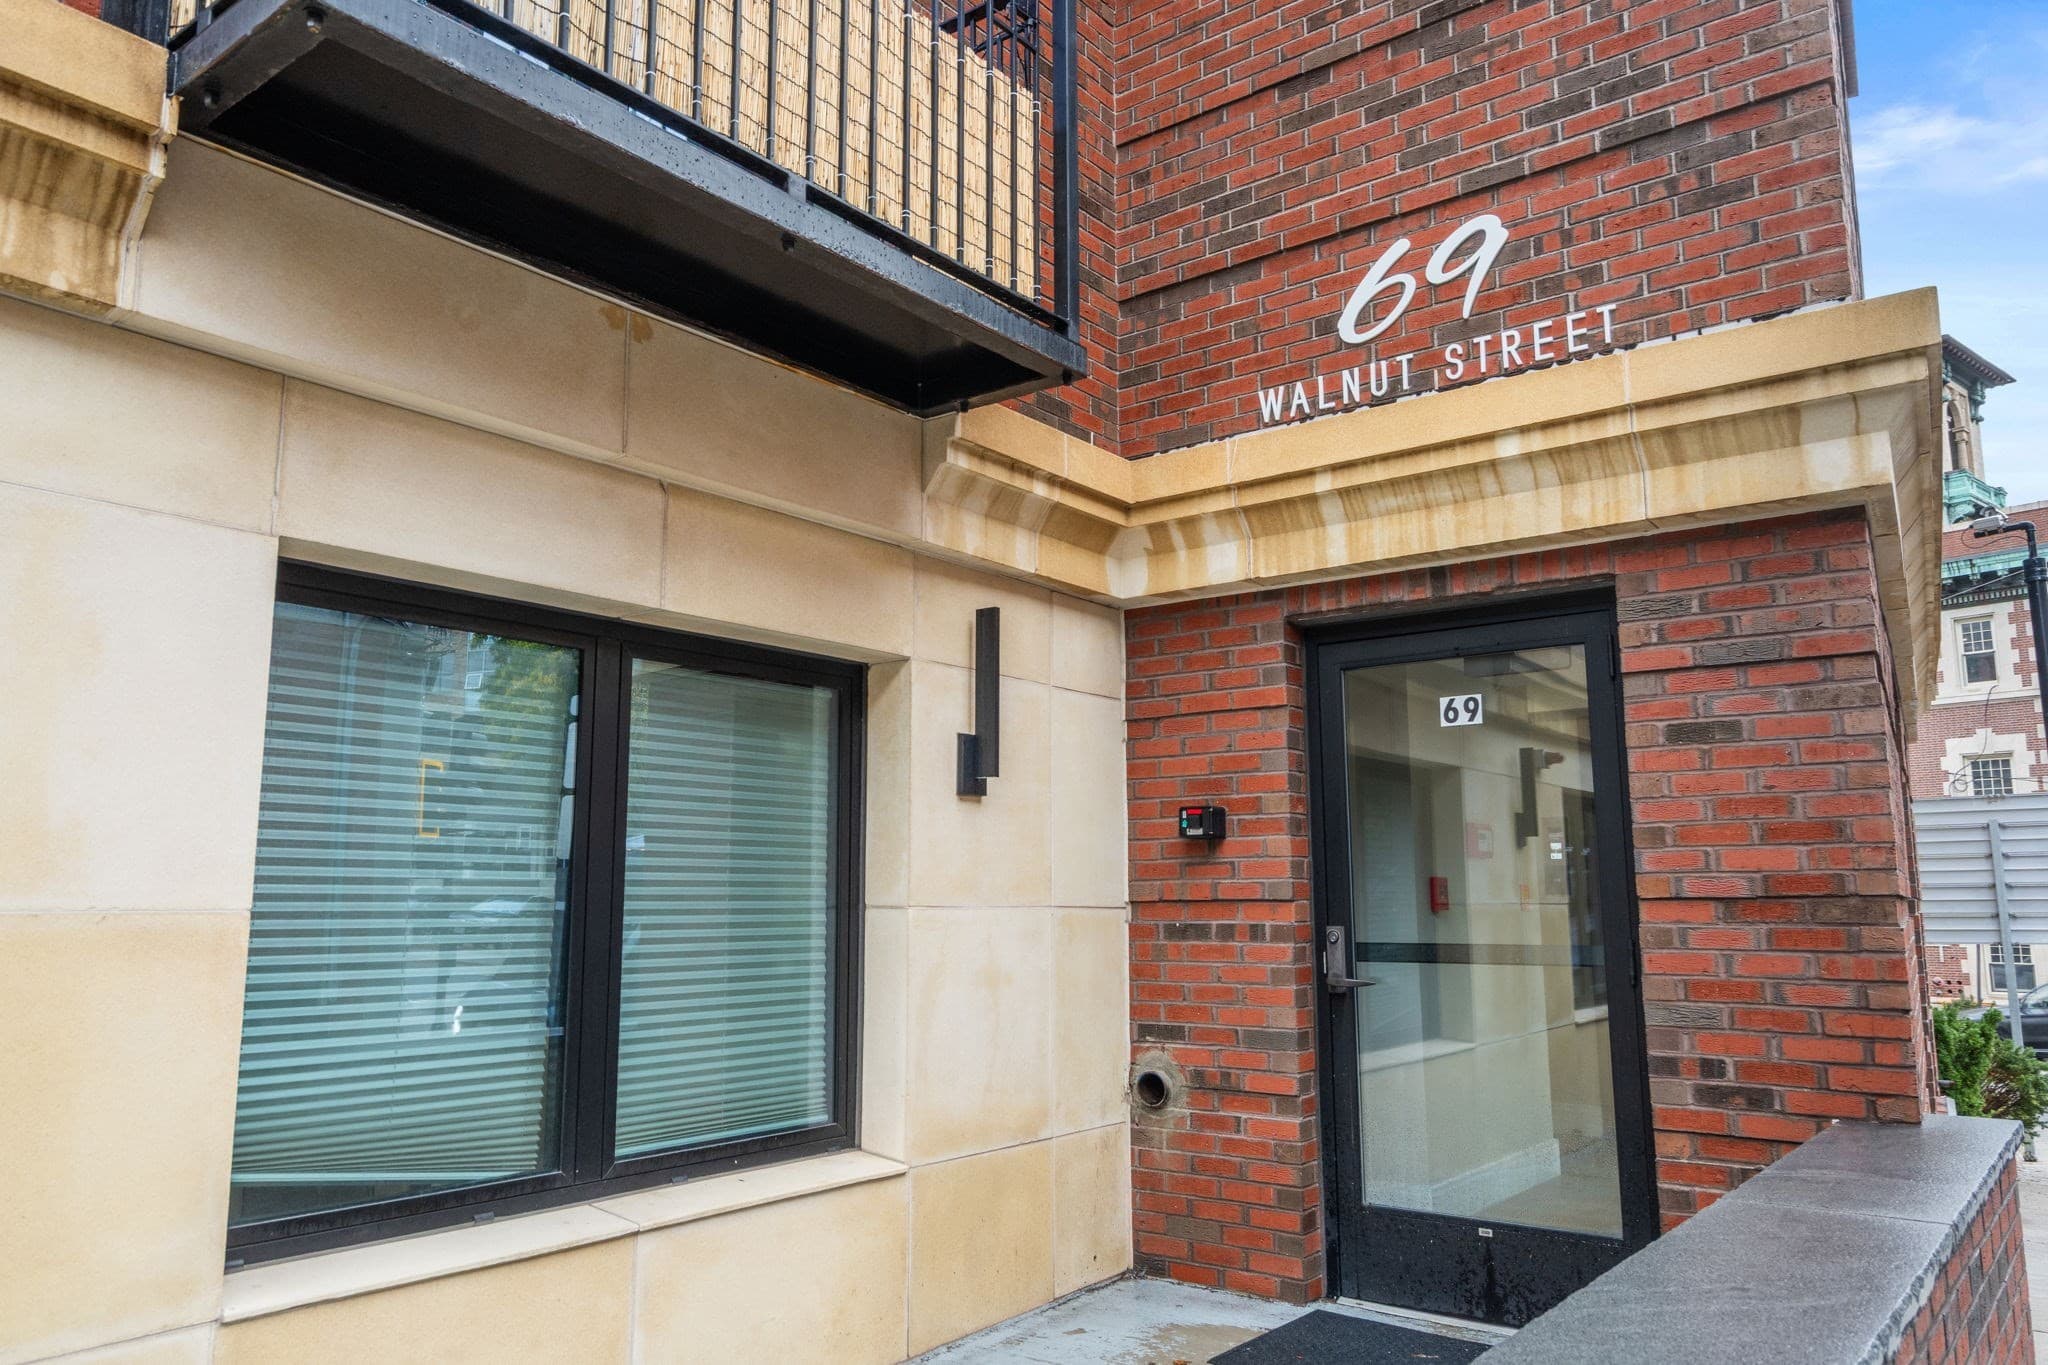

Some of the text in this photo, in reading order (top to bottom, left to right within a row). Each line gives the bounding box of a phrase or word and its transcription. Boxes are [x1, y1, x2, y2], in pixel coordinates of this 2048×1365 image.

[1337, 213, 1509, 344] 69
[1258, 303, 1617, 423] WALNUT STREET
[1443, 696, 1480, 724] 69
